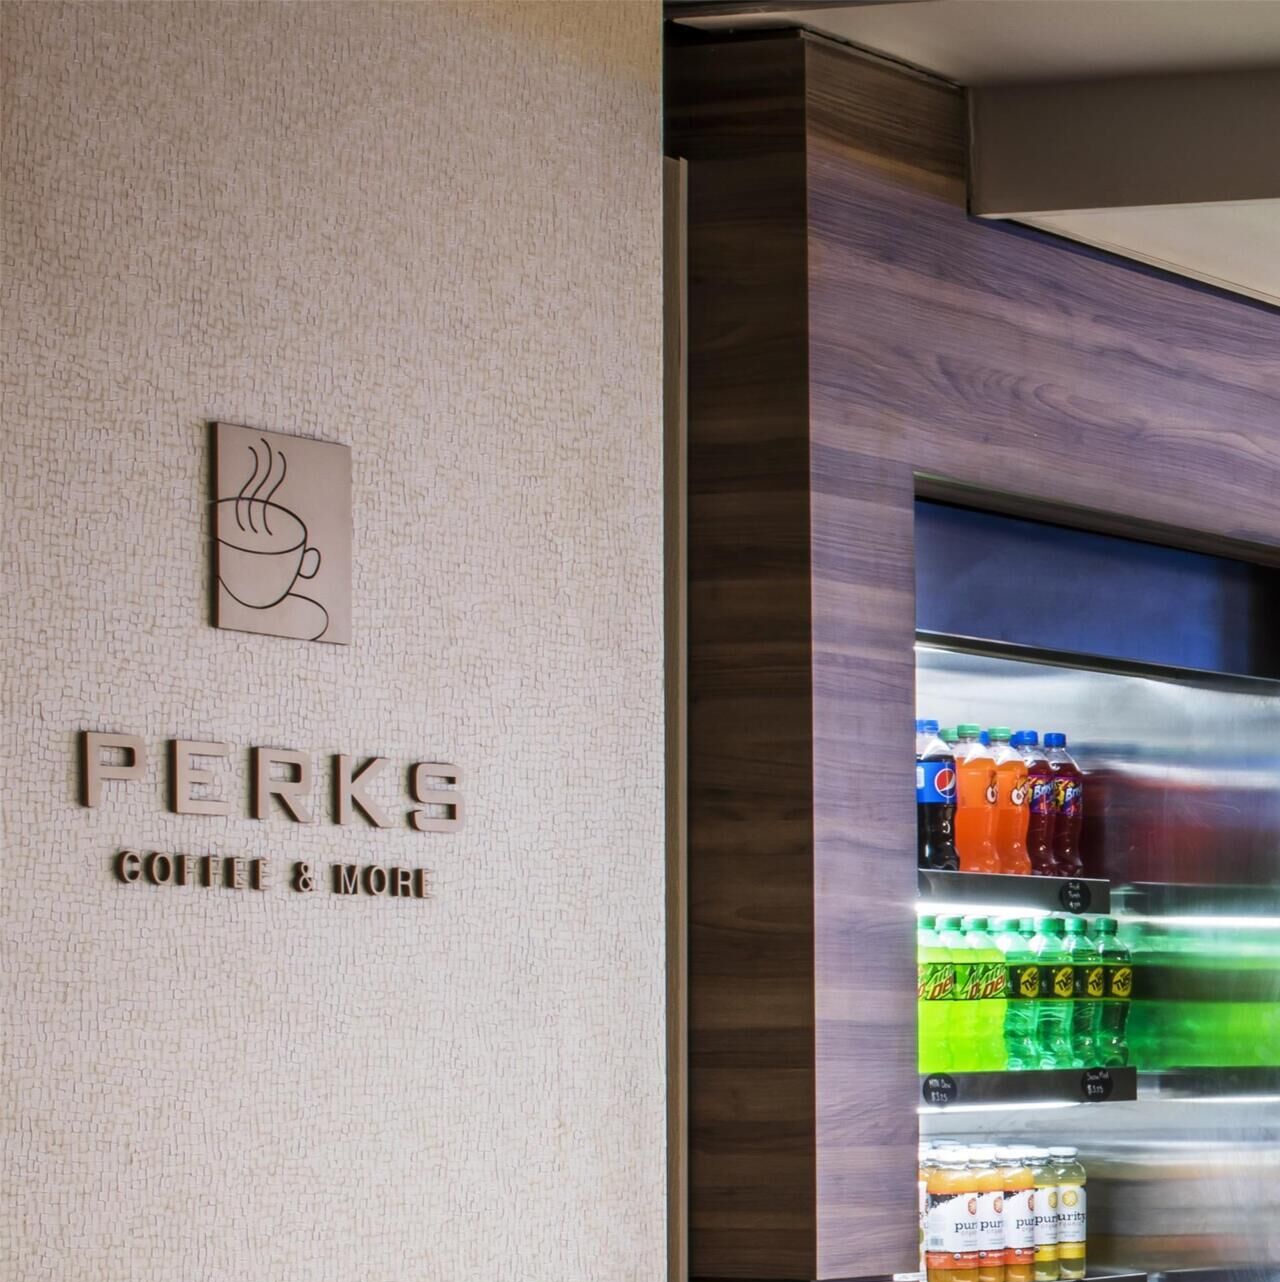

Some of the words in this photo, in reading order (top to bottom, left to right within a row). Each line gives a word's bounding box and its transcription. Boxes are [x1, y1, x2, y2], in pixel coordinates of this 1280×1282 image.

[80, 730, 466, 833] PERKS
[117, 848, 269, 891] COFFEE
[294, 860, 316, 893] &
[332, 863, 435, 900] MORE
